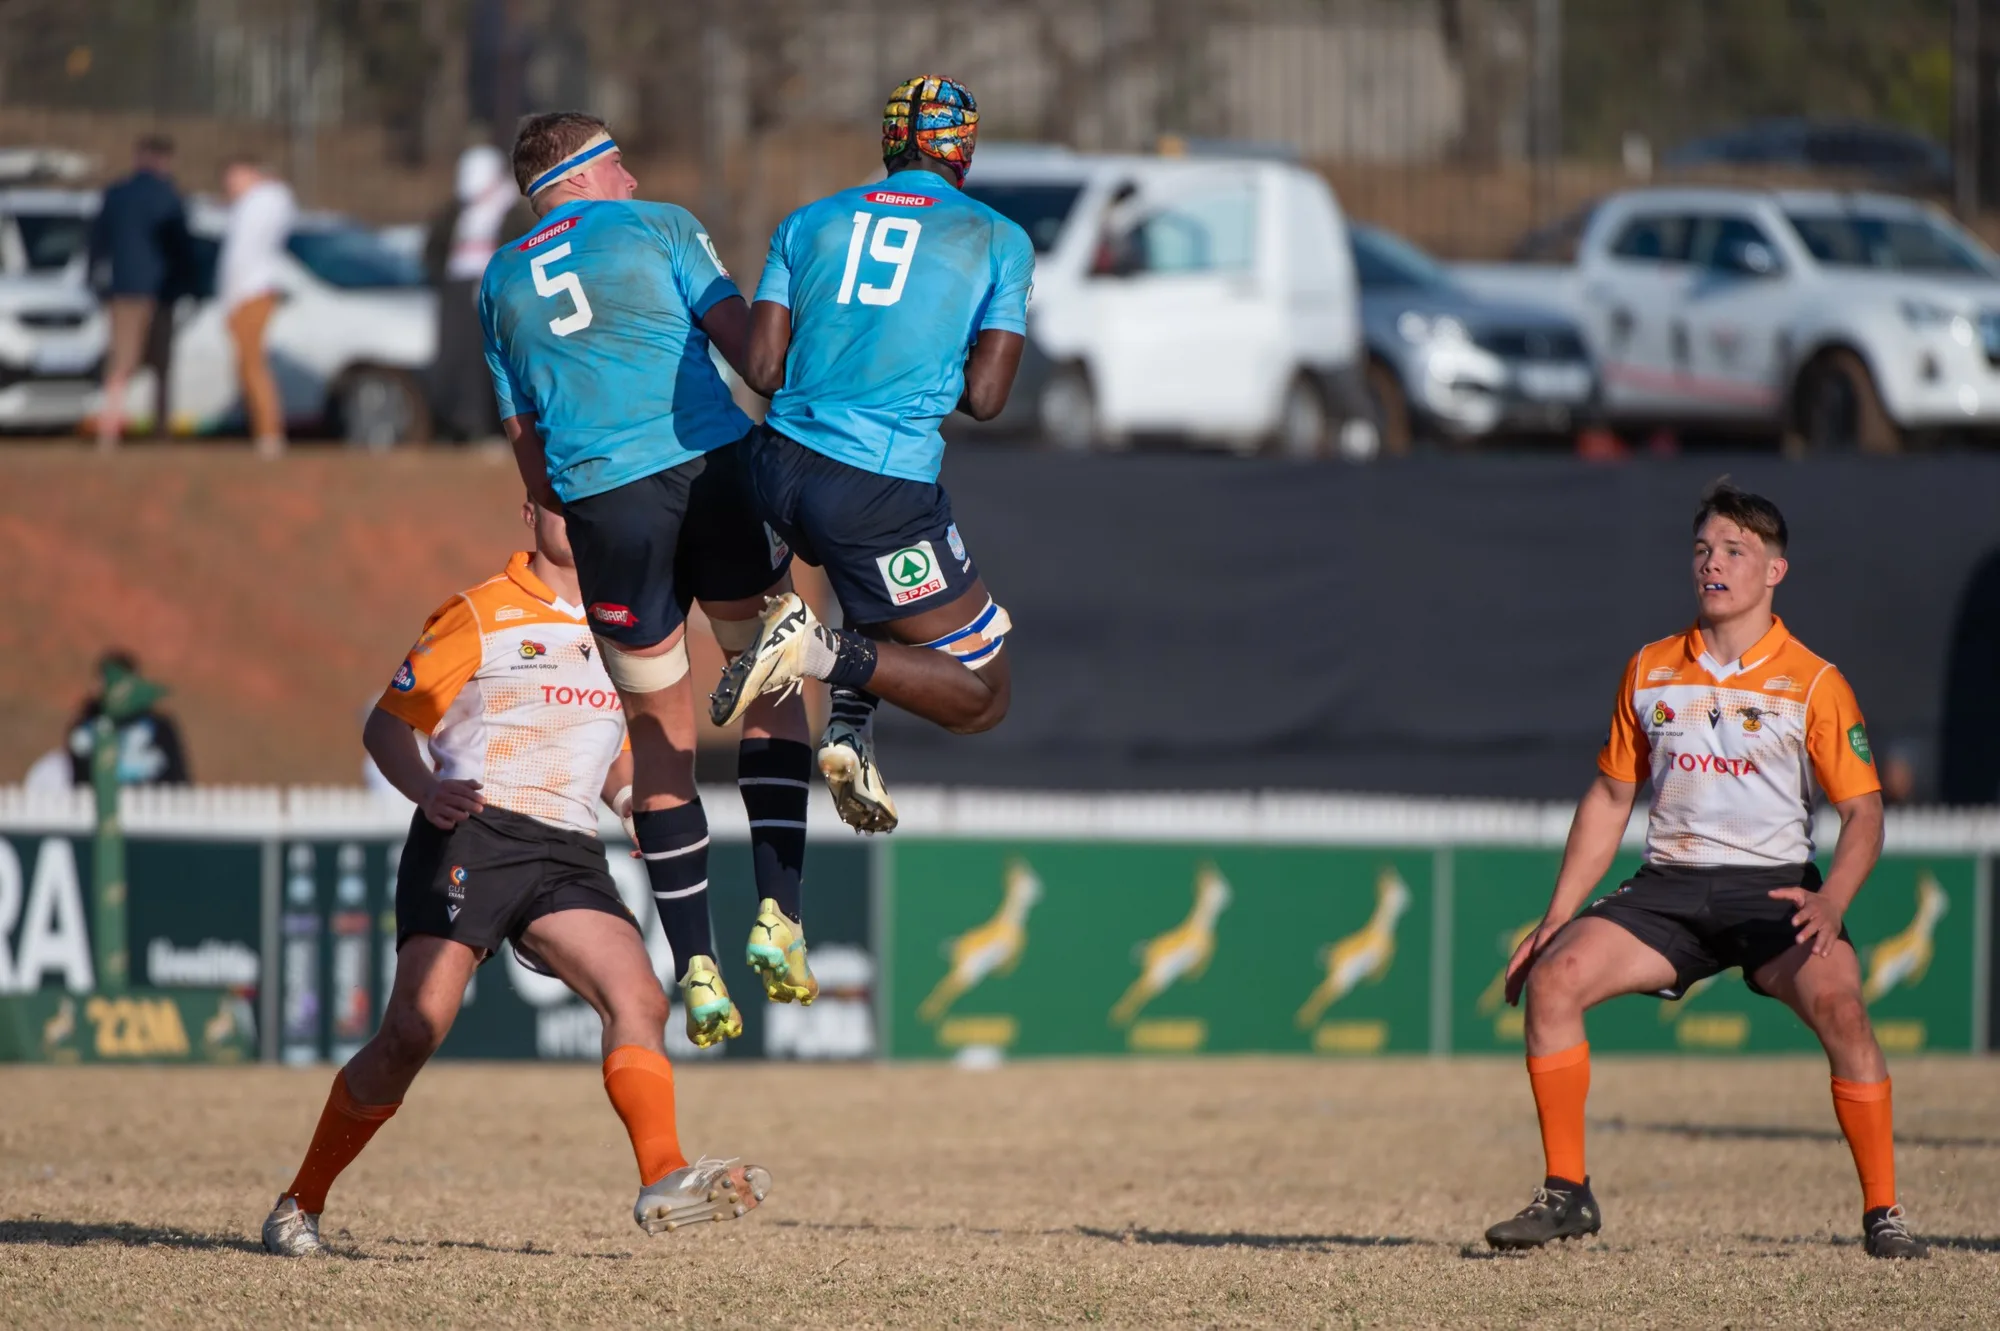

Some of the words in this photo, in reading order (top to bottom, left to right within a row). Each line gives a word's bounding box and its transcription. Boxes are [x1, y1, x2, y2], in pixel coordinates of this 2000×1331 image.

[875, 193, 926, 206] OBARO
[528, 220, 570, 247] OBARO
[837, 211, 923, 307] 19
[530, 241, 594, 337] 5
[897, 579, 940, 602] SPAR
[510, 663, 538, 671] WISEMAN
[1667, 752, 1761, 776] TOYOTA
[448, 884, 465, 893] CUT
